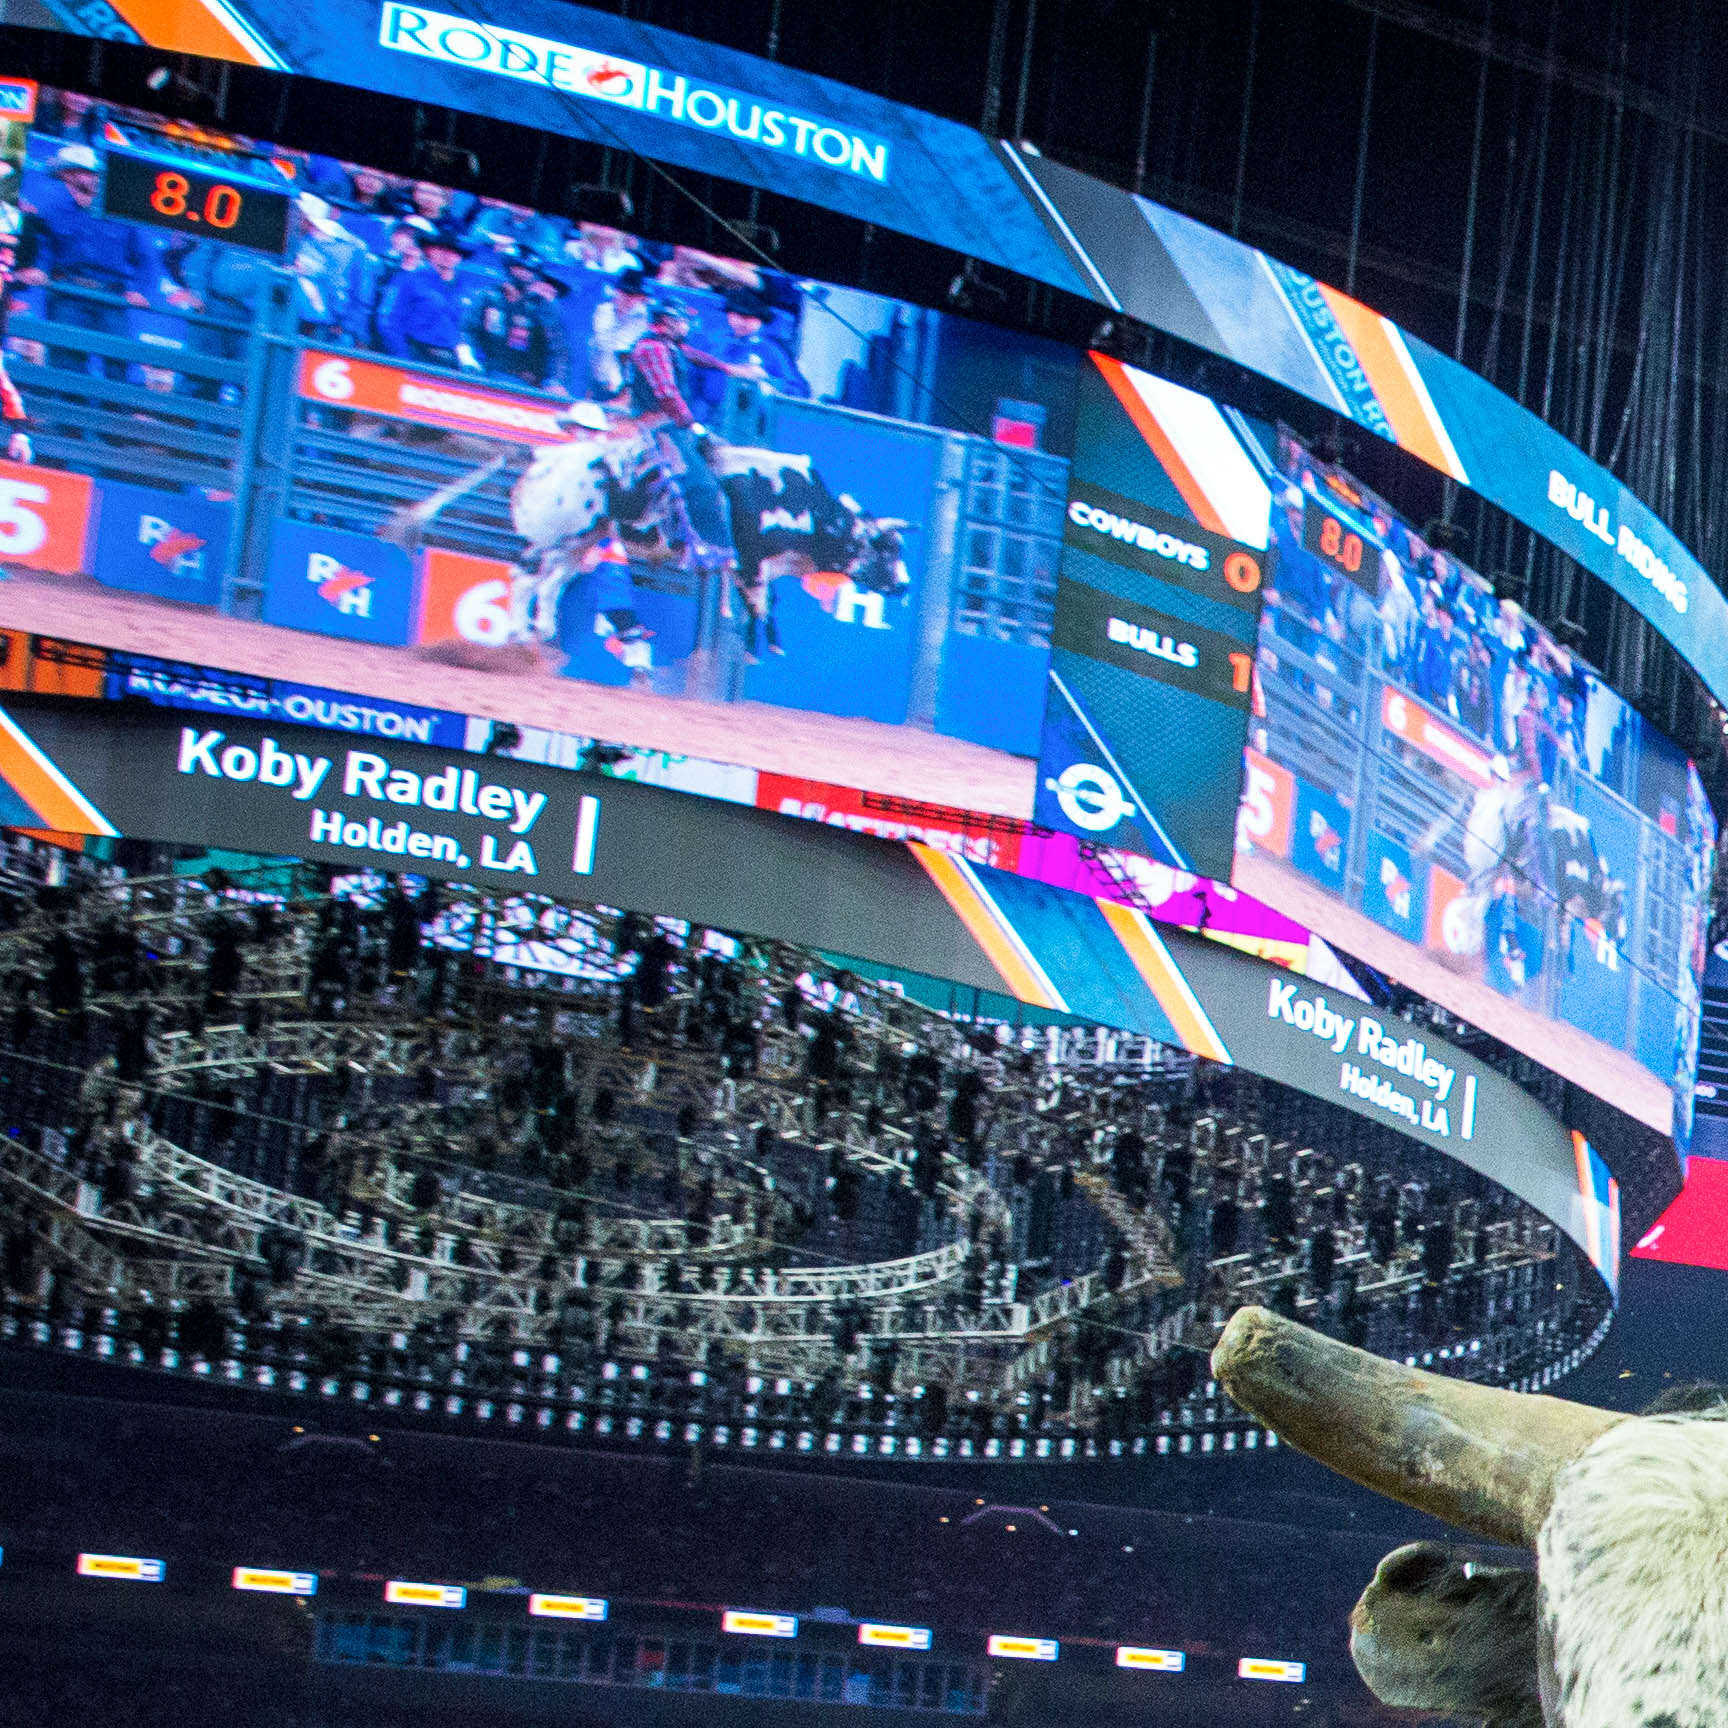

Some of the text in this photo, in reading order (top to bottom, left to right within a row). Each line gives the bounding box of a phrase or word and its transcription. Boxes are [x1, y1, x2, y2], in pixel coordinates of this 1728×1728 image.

[150, 171, 241, 229] 8.0
[314, 360, 355, 399] 6
[0, 478, 48, 556] 5
[1068, 501, 1261, 593] COWBOYS 0
[1320, 517, 1363, 572] 8.0
[1548, 470, 1688, 614] BULL RIDING
[454, 580, 510, 648] 6
[1107, 617, 1251, 692] BULLS 1
[177, 726, 548, 834] Koby Radley
[310, 808, 539, 876] Holden, LA
[1268, 978, 1456, 1102] Koby Radley
[1340, 1062, 1450, 1137] Holden, LA
